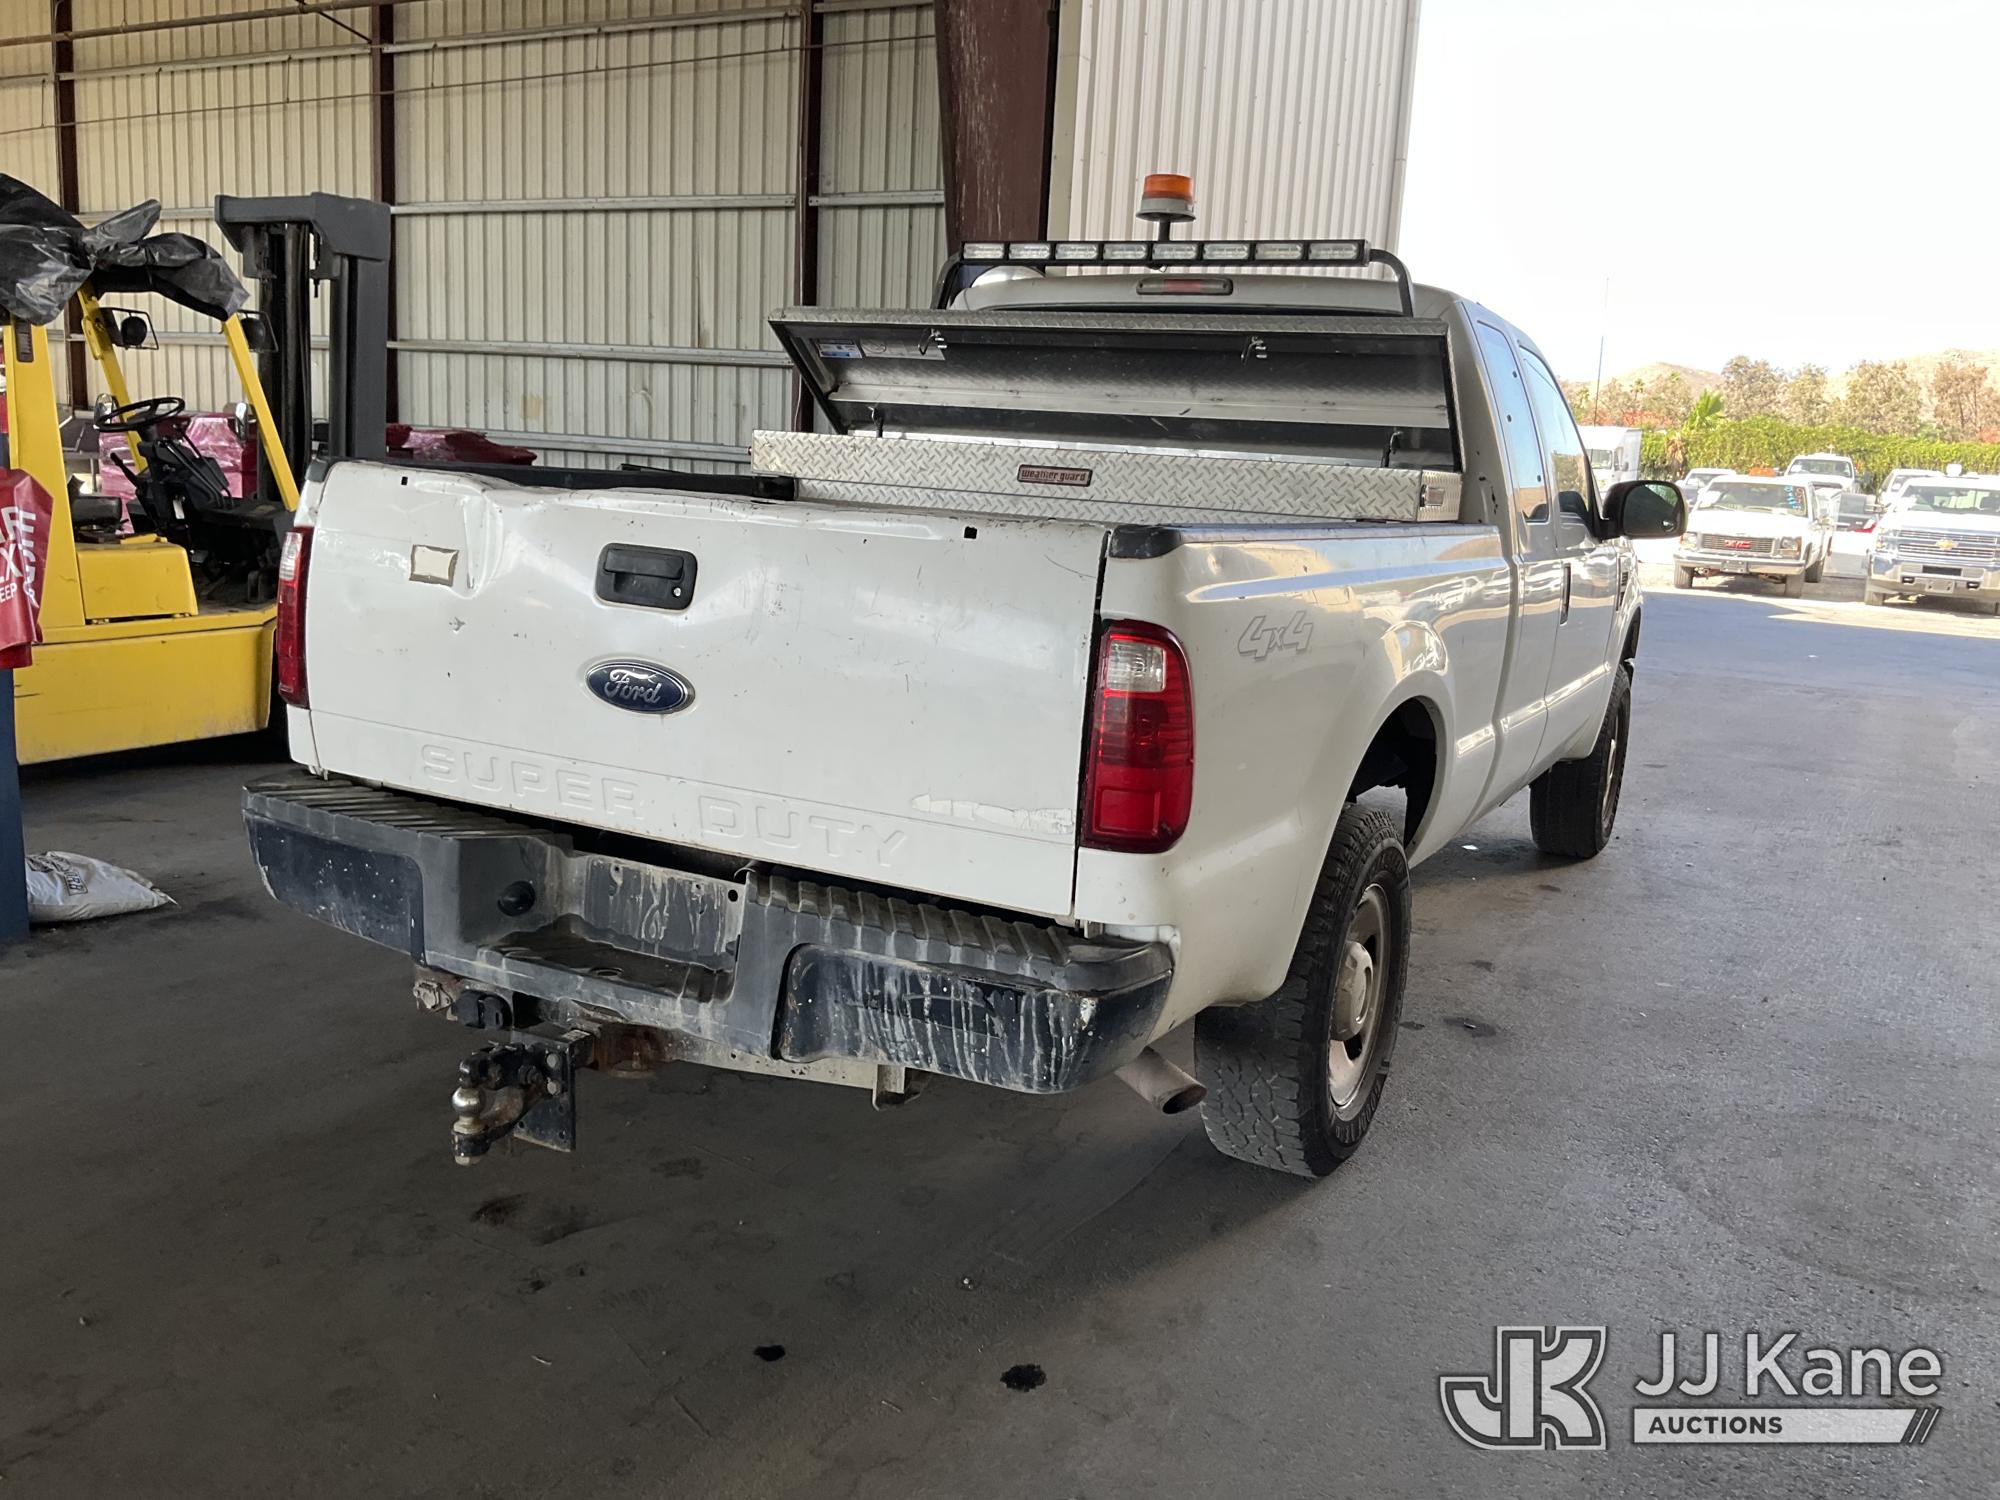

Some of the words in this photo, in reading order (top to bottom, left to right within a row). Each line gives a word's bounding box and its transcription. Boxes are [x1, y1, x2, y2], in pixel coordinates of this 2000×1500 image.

[1059, 472, 1086, 482] guard
[1237, 610, 1314, 661] 4x4
[603, 668, 662, 704] Ford
[421, 743, 646, 821] SUPER
[697, 794, 909, 868] DUTY
